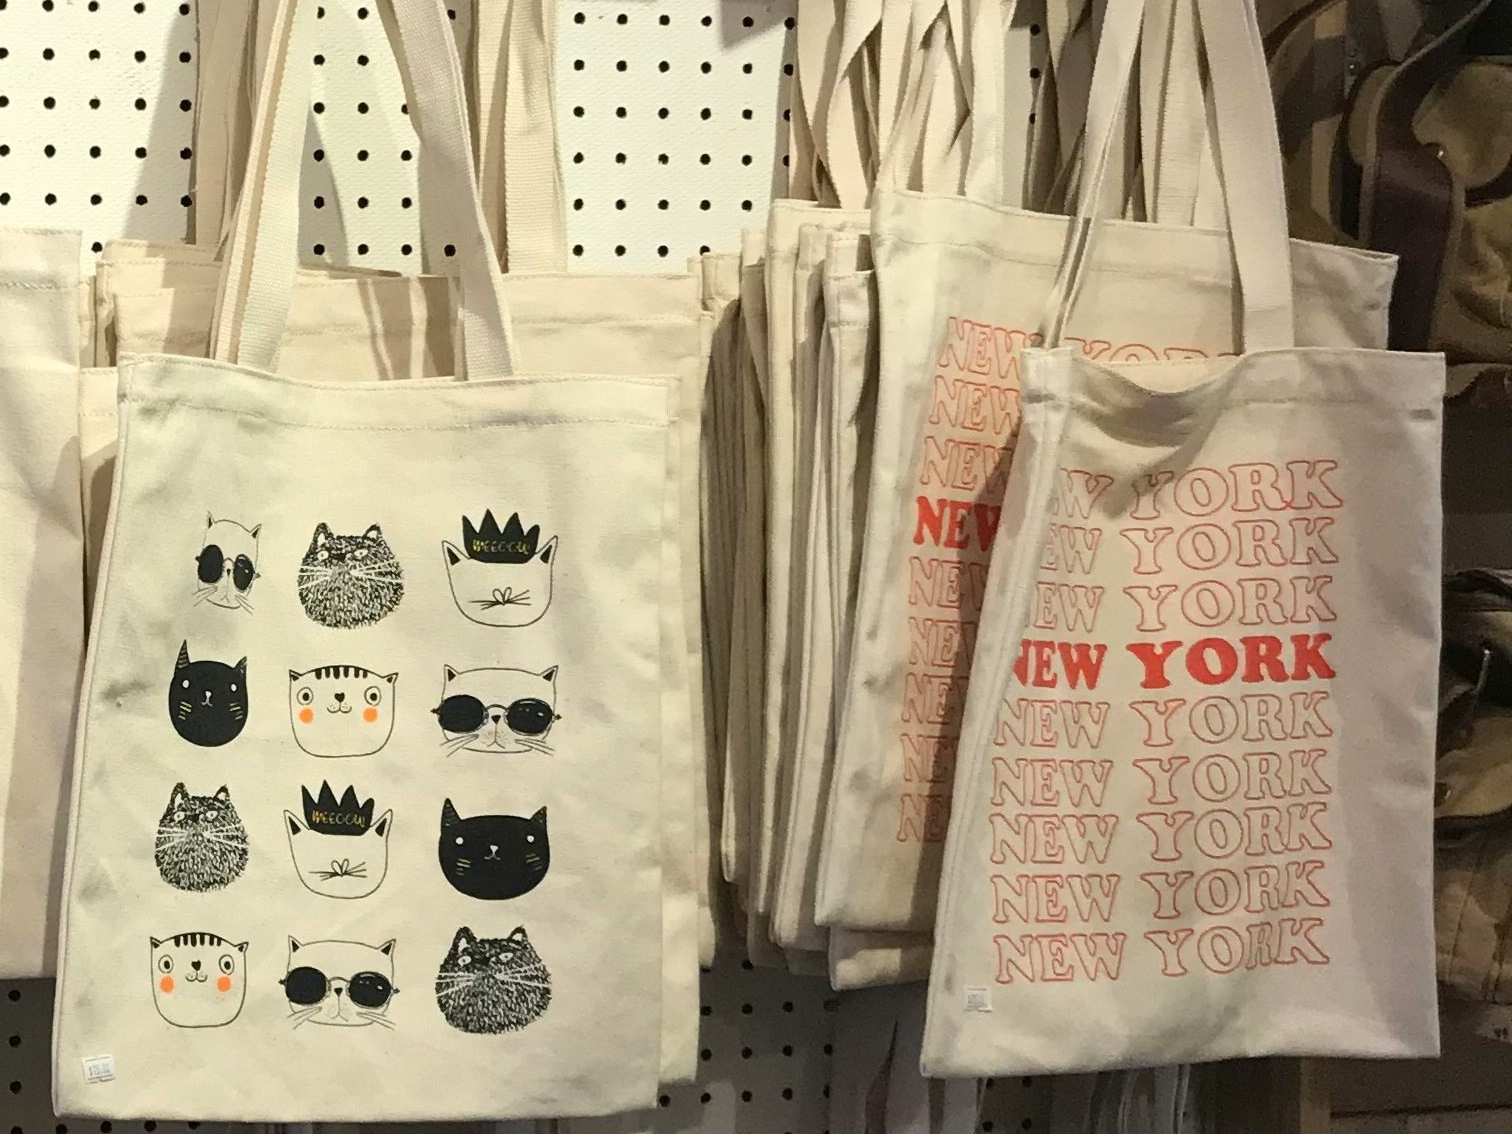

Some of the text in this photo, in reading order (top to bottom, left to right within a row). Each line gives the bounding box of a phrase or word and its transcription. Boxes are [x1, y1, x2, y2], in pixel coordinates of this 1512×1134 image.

[1129, 459, 1344, 521] YORK
[1039, 516, 1339, 576] EW YORK
[1032, 575, 1338, 633] EW YORK
[907, 616, 977, 668] NE
[1126, 632, 1336, 690] YORK
[900, 671, 971, 725] NE
[992, 690, 1335, 750] NEW YORK
[899, 733, 960, 783] NE
[990, 748, 1333, 808] NEW YORK
[989, 801, 1333, 865] NEW YORK
[989, 860, 1332, 925] NEW YORK
[992, 917, 1331, 985] NEW YORK
